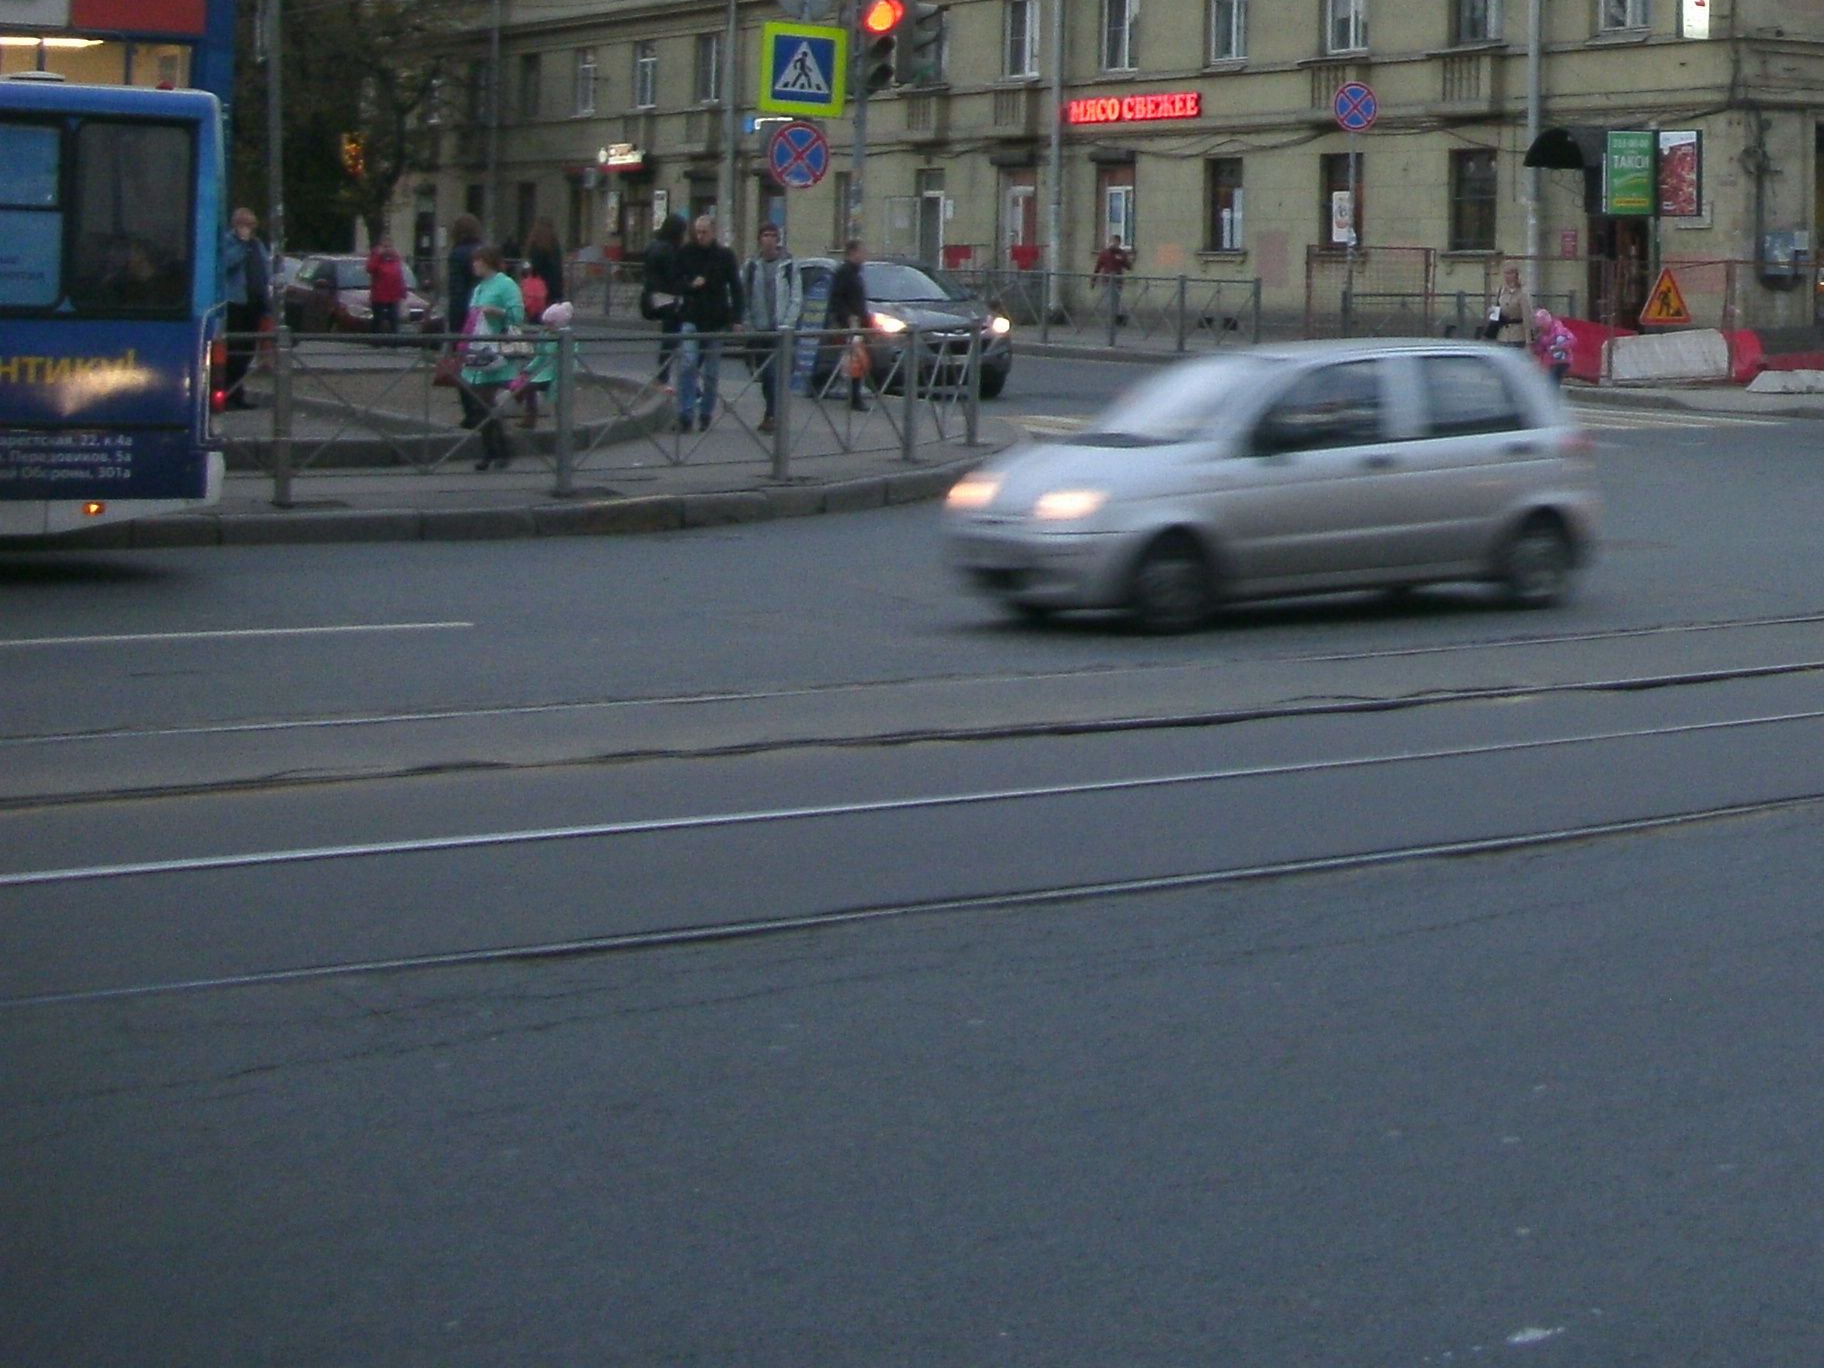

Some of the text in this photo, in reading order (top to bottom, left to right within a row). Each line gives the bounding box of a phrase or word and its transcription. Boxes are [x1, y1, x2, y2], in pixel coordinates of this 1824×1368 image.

[1070, 92, 1199, 123] МЯСО СВЕЖЕЕ
[1613, 154, 1650, 169] ТАКСИ
